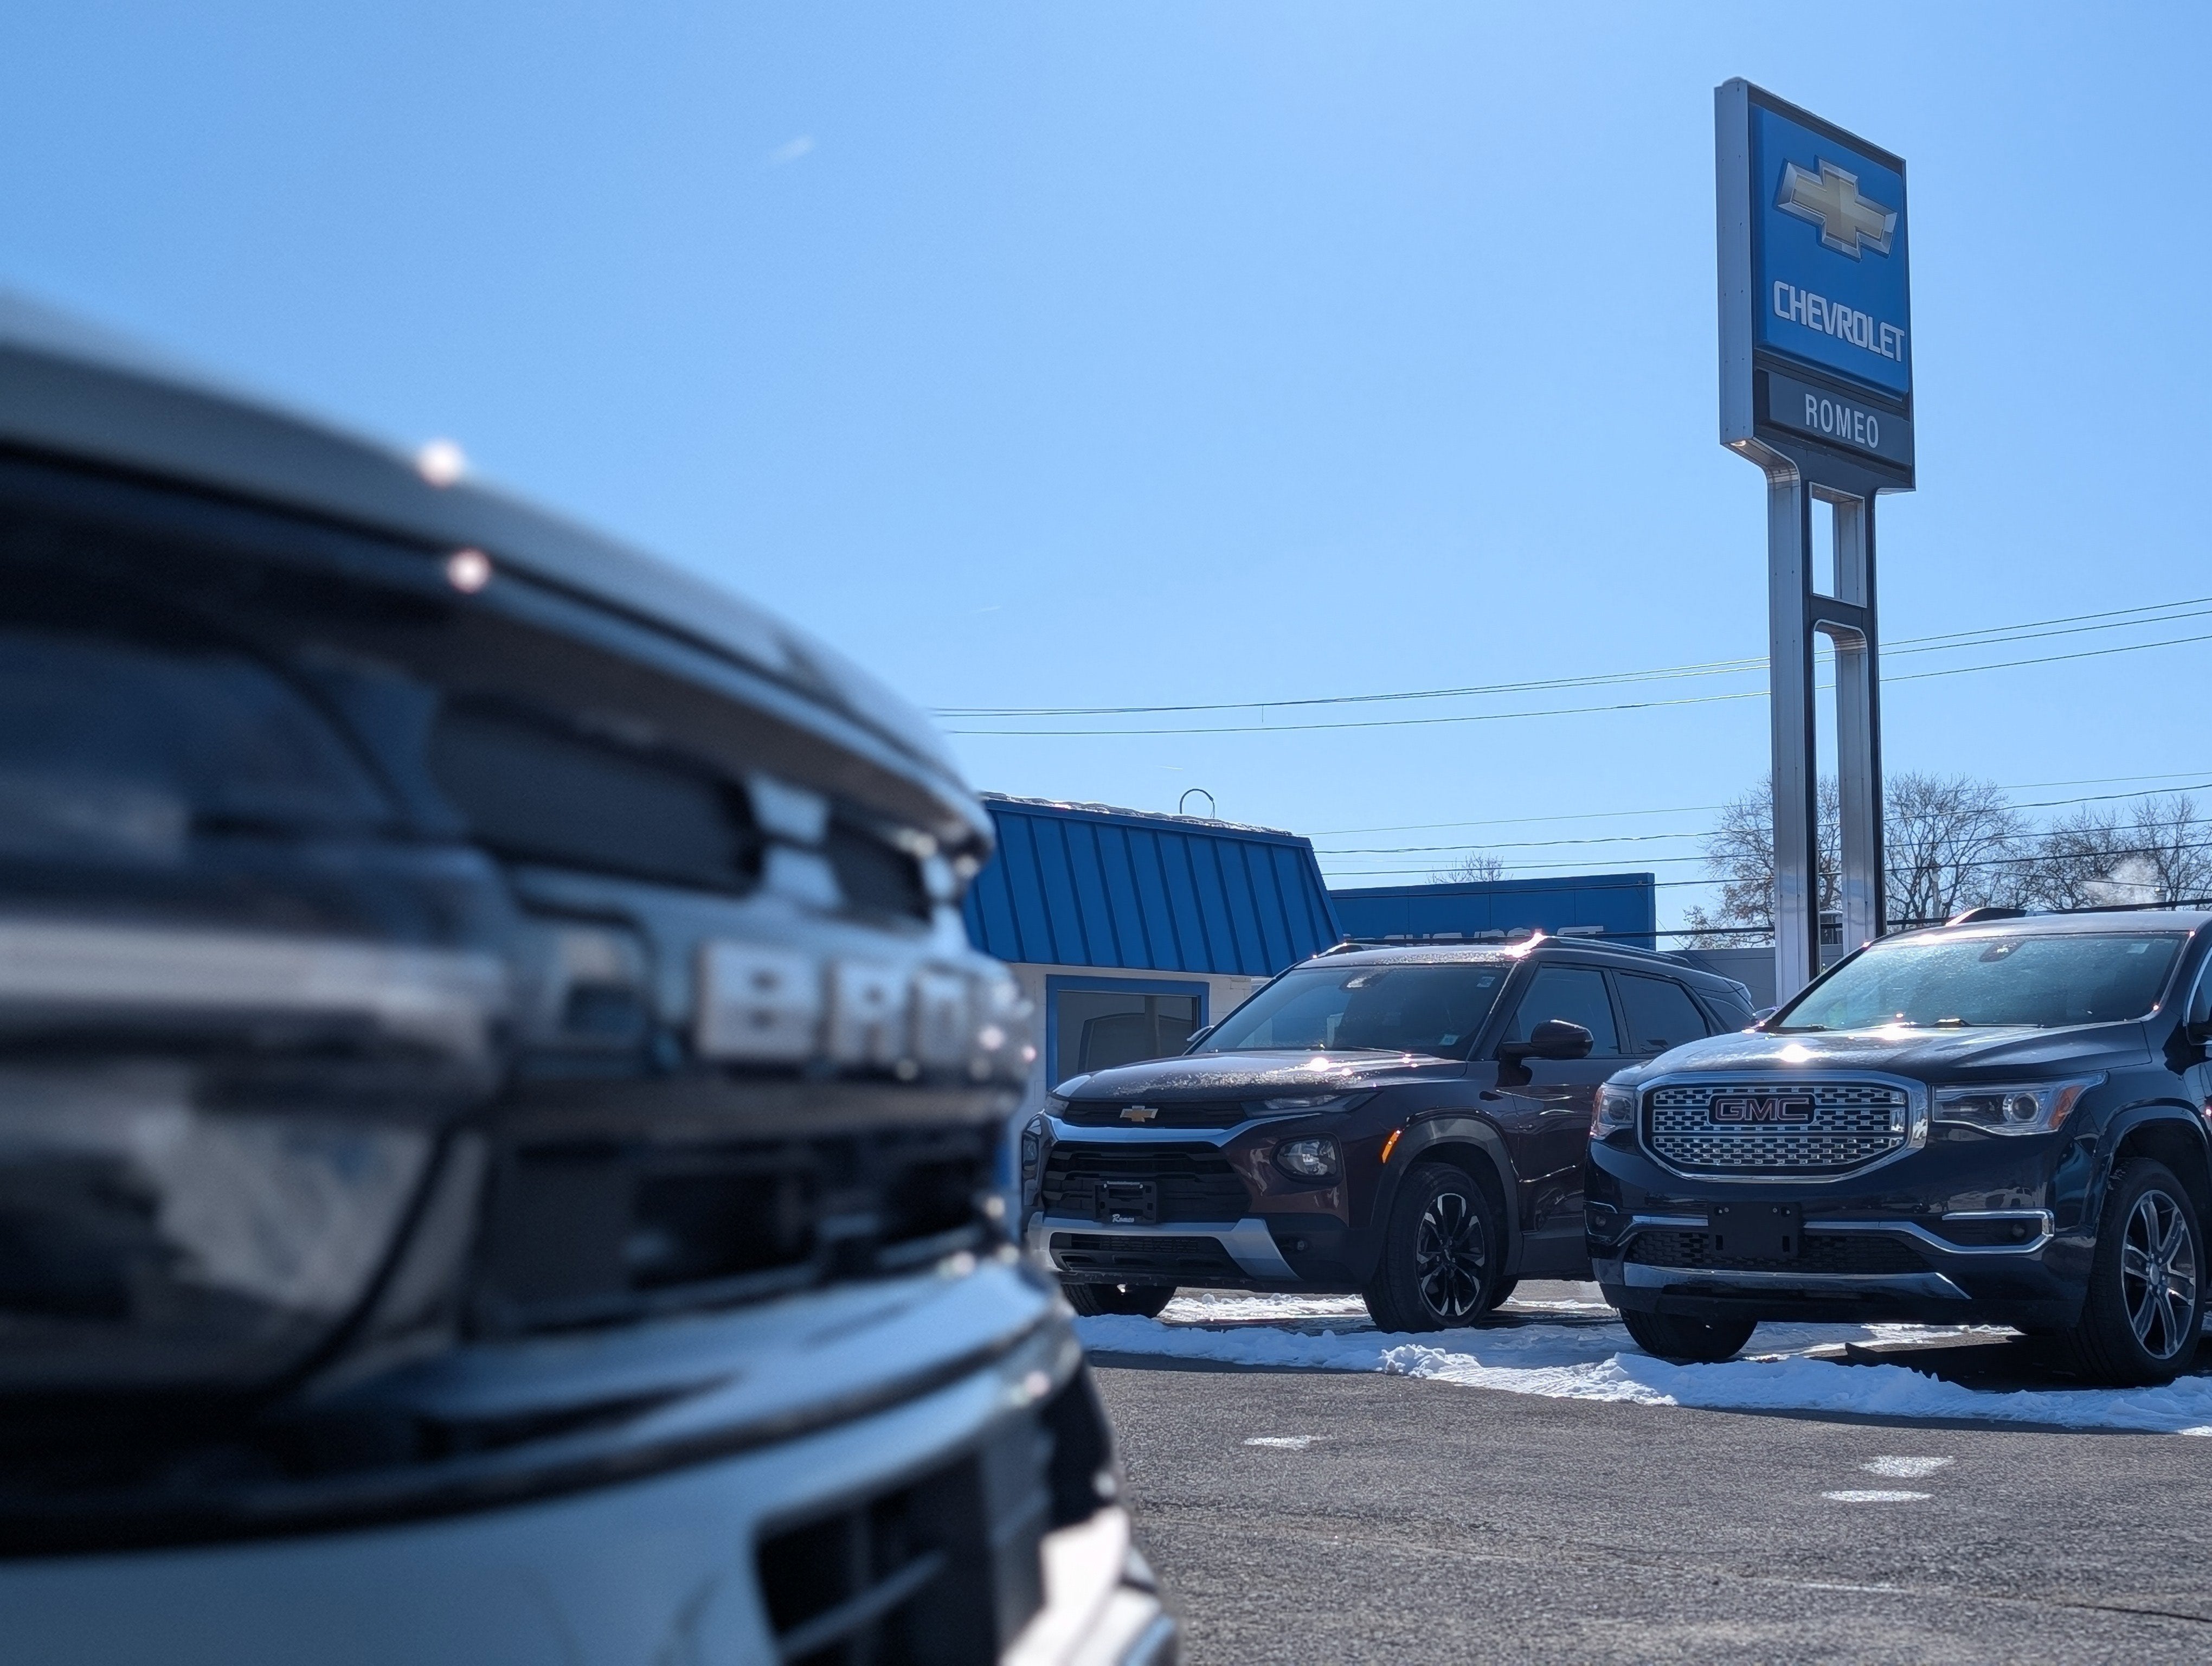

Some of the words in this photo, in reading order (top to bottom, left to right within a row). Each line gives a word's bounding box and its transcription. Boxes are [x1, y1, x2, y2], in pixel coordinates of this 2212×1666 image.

[1773, 280, 1905, 362] CHEVROLET
[1805, 393, 1879, 449] ROMEO
[1715, 1097, 1810, 1122] GMC
